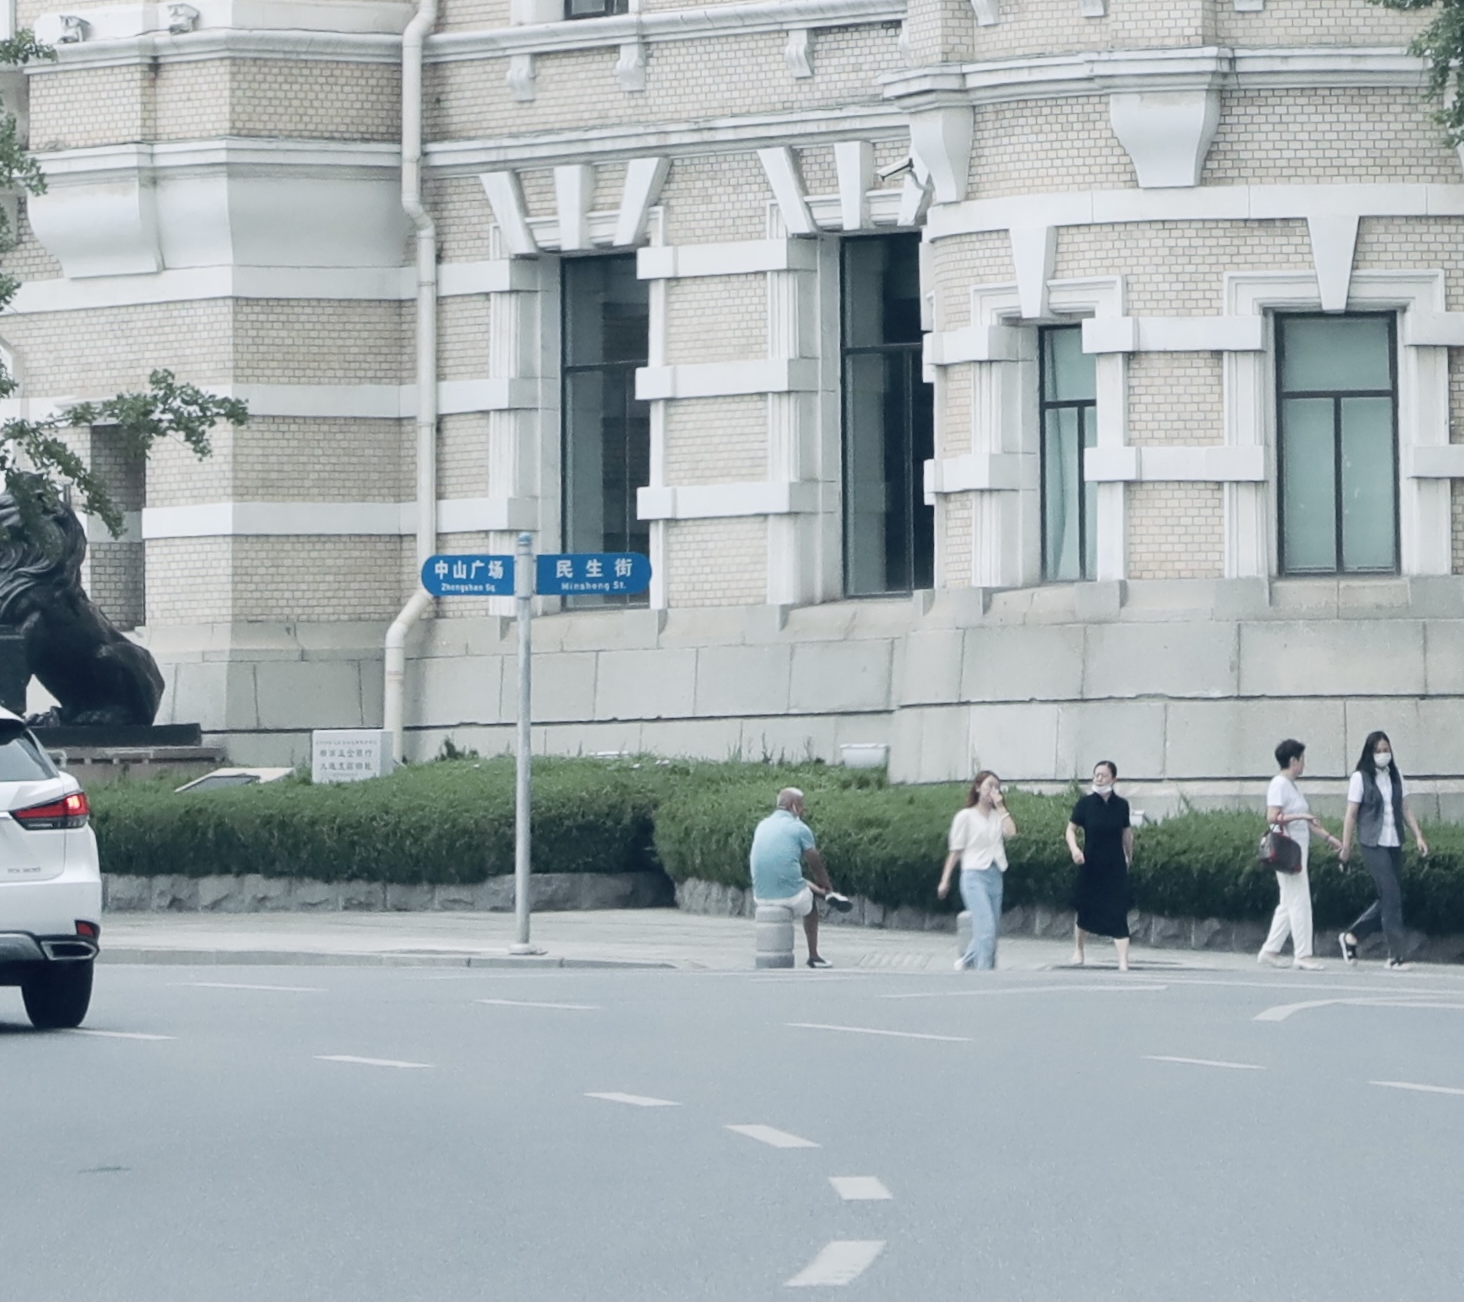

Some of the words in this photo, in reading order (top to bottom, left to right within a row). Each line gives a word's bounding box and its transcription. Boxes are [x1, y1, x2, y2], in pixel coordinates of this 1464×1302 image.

[434, 559, 504, 580] 中山广场
[556, 558, 633, 578] 民生街
